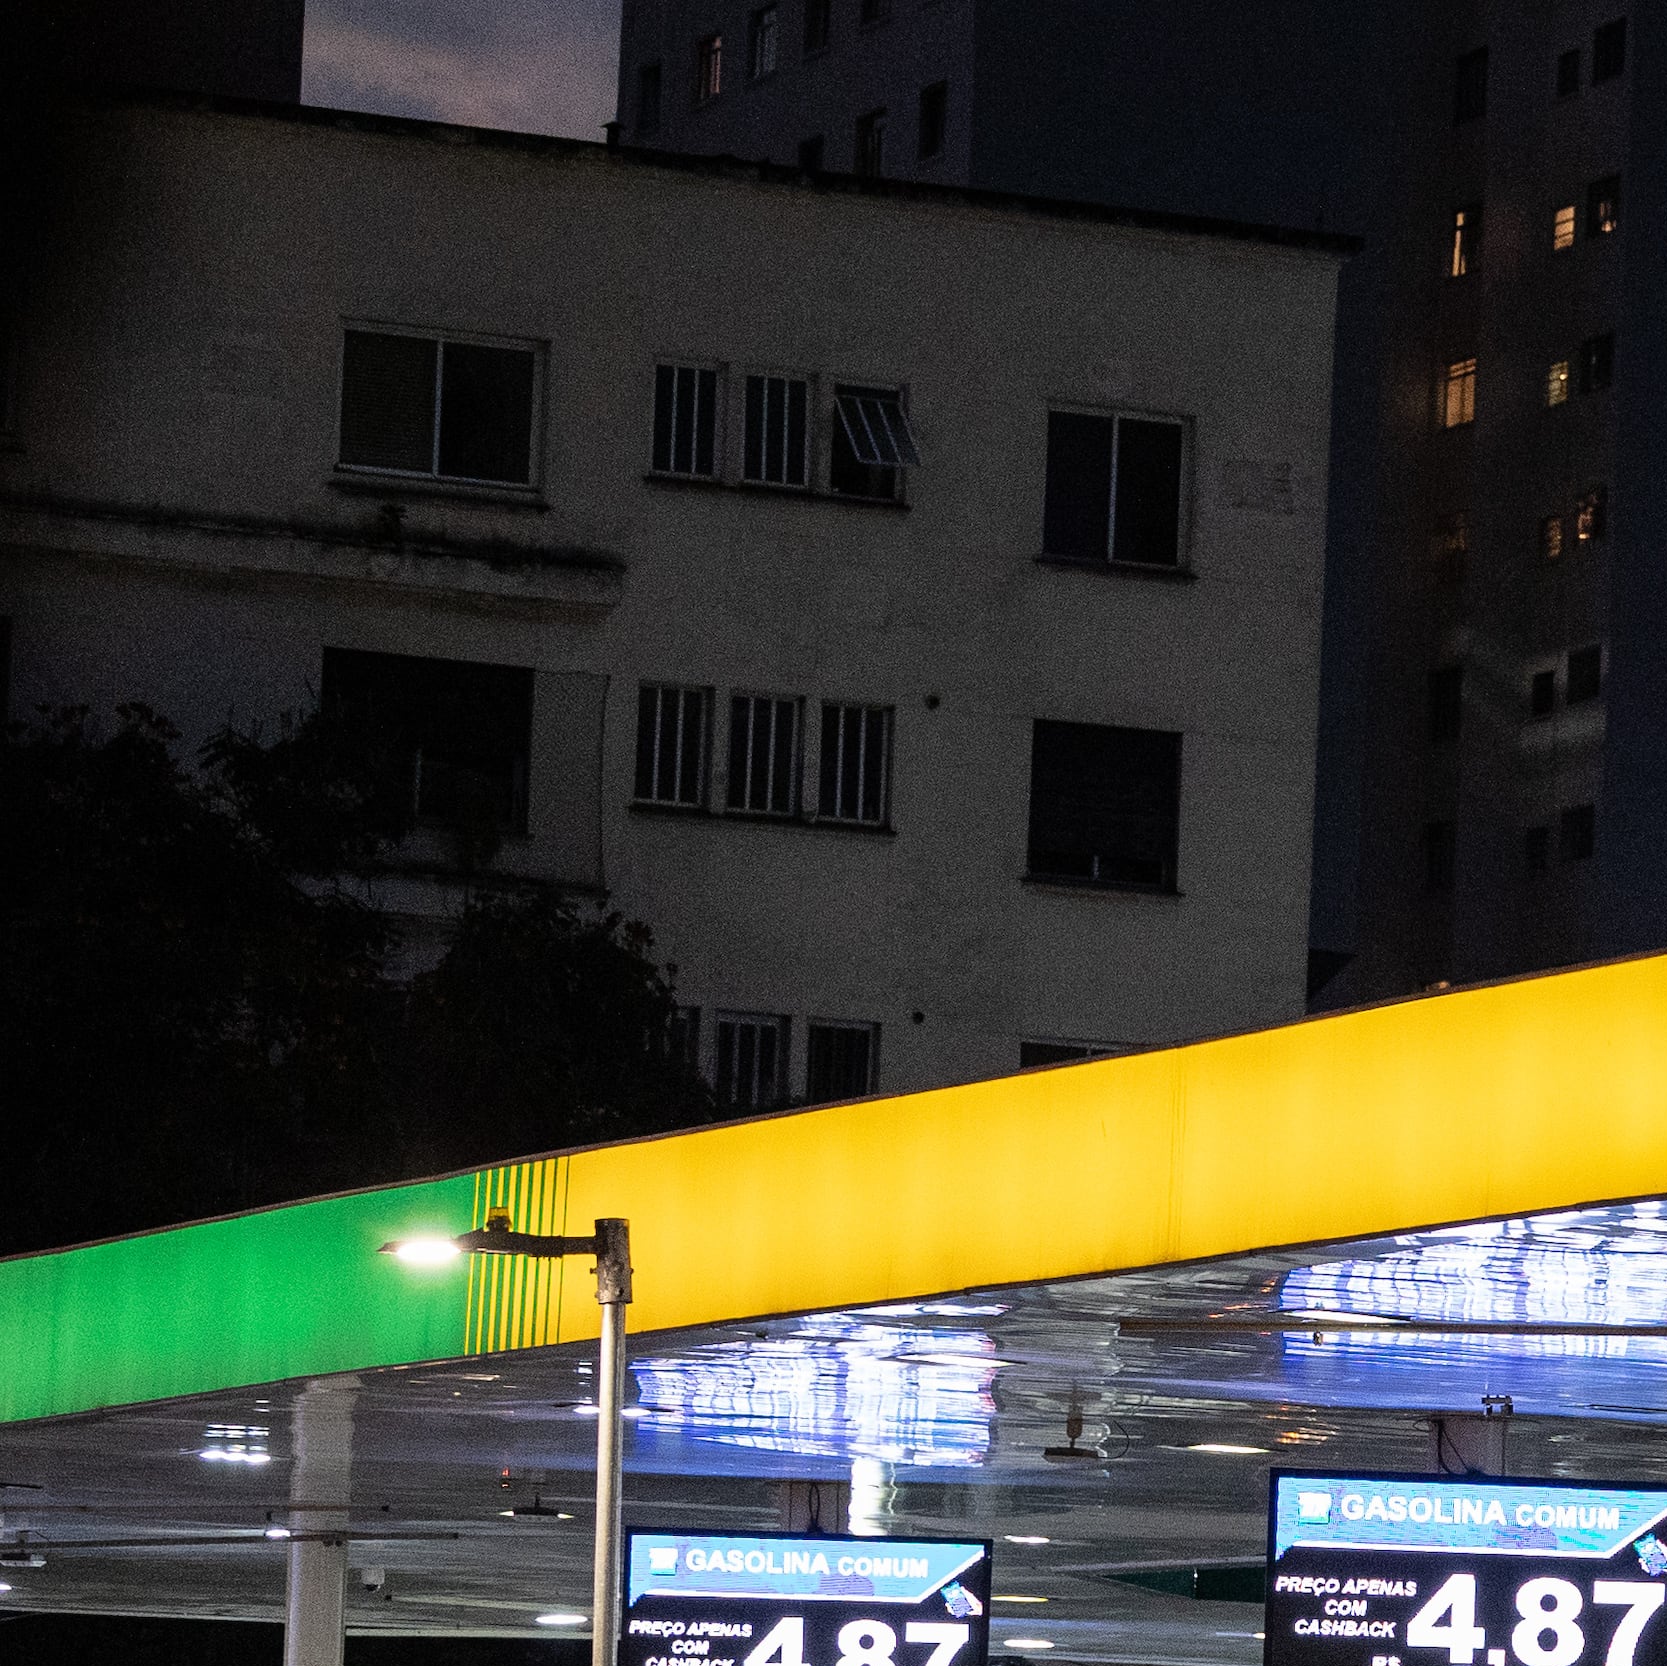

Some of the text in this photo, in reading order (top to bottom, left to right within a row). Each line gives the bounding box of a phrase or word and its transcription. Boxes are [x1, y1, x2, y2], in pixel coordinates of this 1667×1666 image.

[1341, 1494, 1620, 1530] GASOLINA COMUM
[686, 1549, 929, 1578] GASOLINA COMUM
[1275, 1576, 1417, 1597] PREÇO APENAS
[1325, 1599, 1367, 1617] COM
[629, 1620, 752, 1638] PREÇO APENAS
[1294, 1619, 1396, 1638] CASHBACK
[671, 1640, 709, 1655] COM
